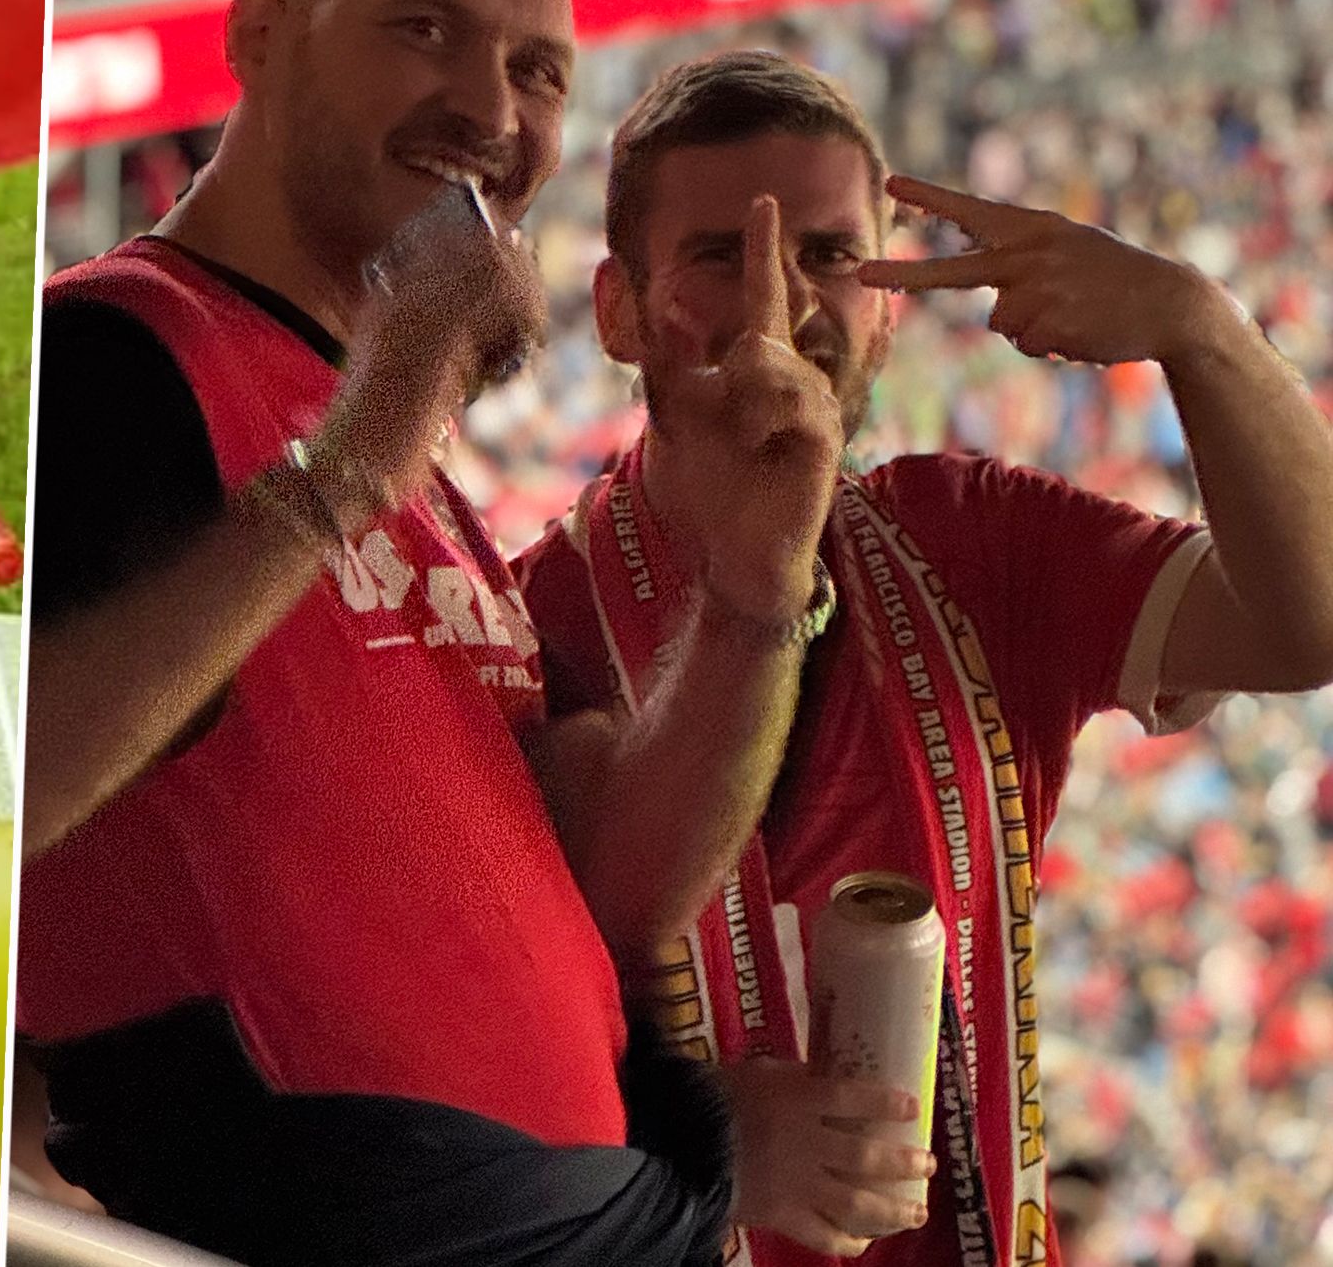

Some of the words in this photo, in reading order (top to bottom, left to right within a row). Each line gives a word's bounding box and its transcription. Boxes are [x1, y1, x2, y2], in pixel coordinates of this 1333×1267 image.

[854, 525, 916, 647] FRANCISCO
[901, 652, 933, 701] BAY
[918, 709, 955, 779] AREA
[937, 786, 972, 891] STADION
